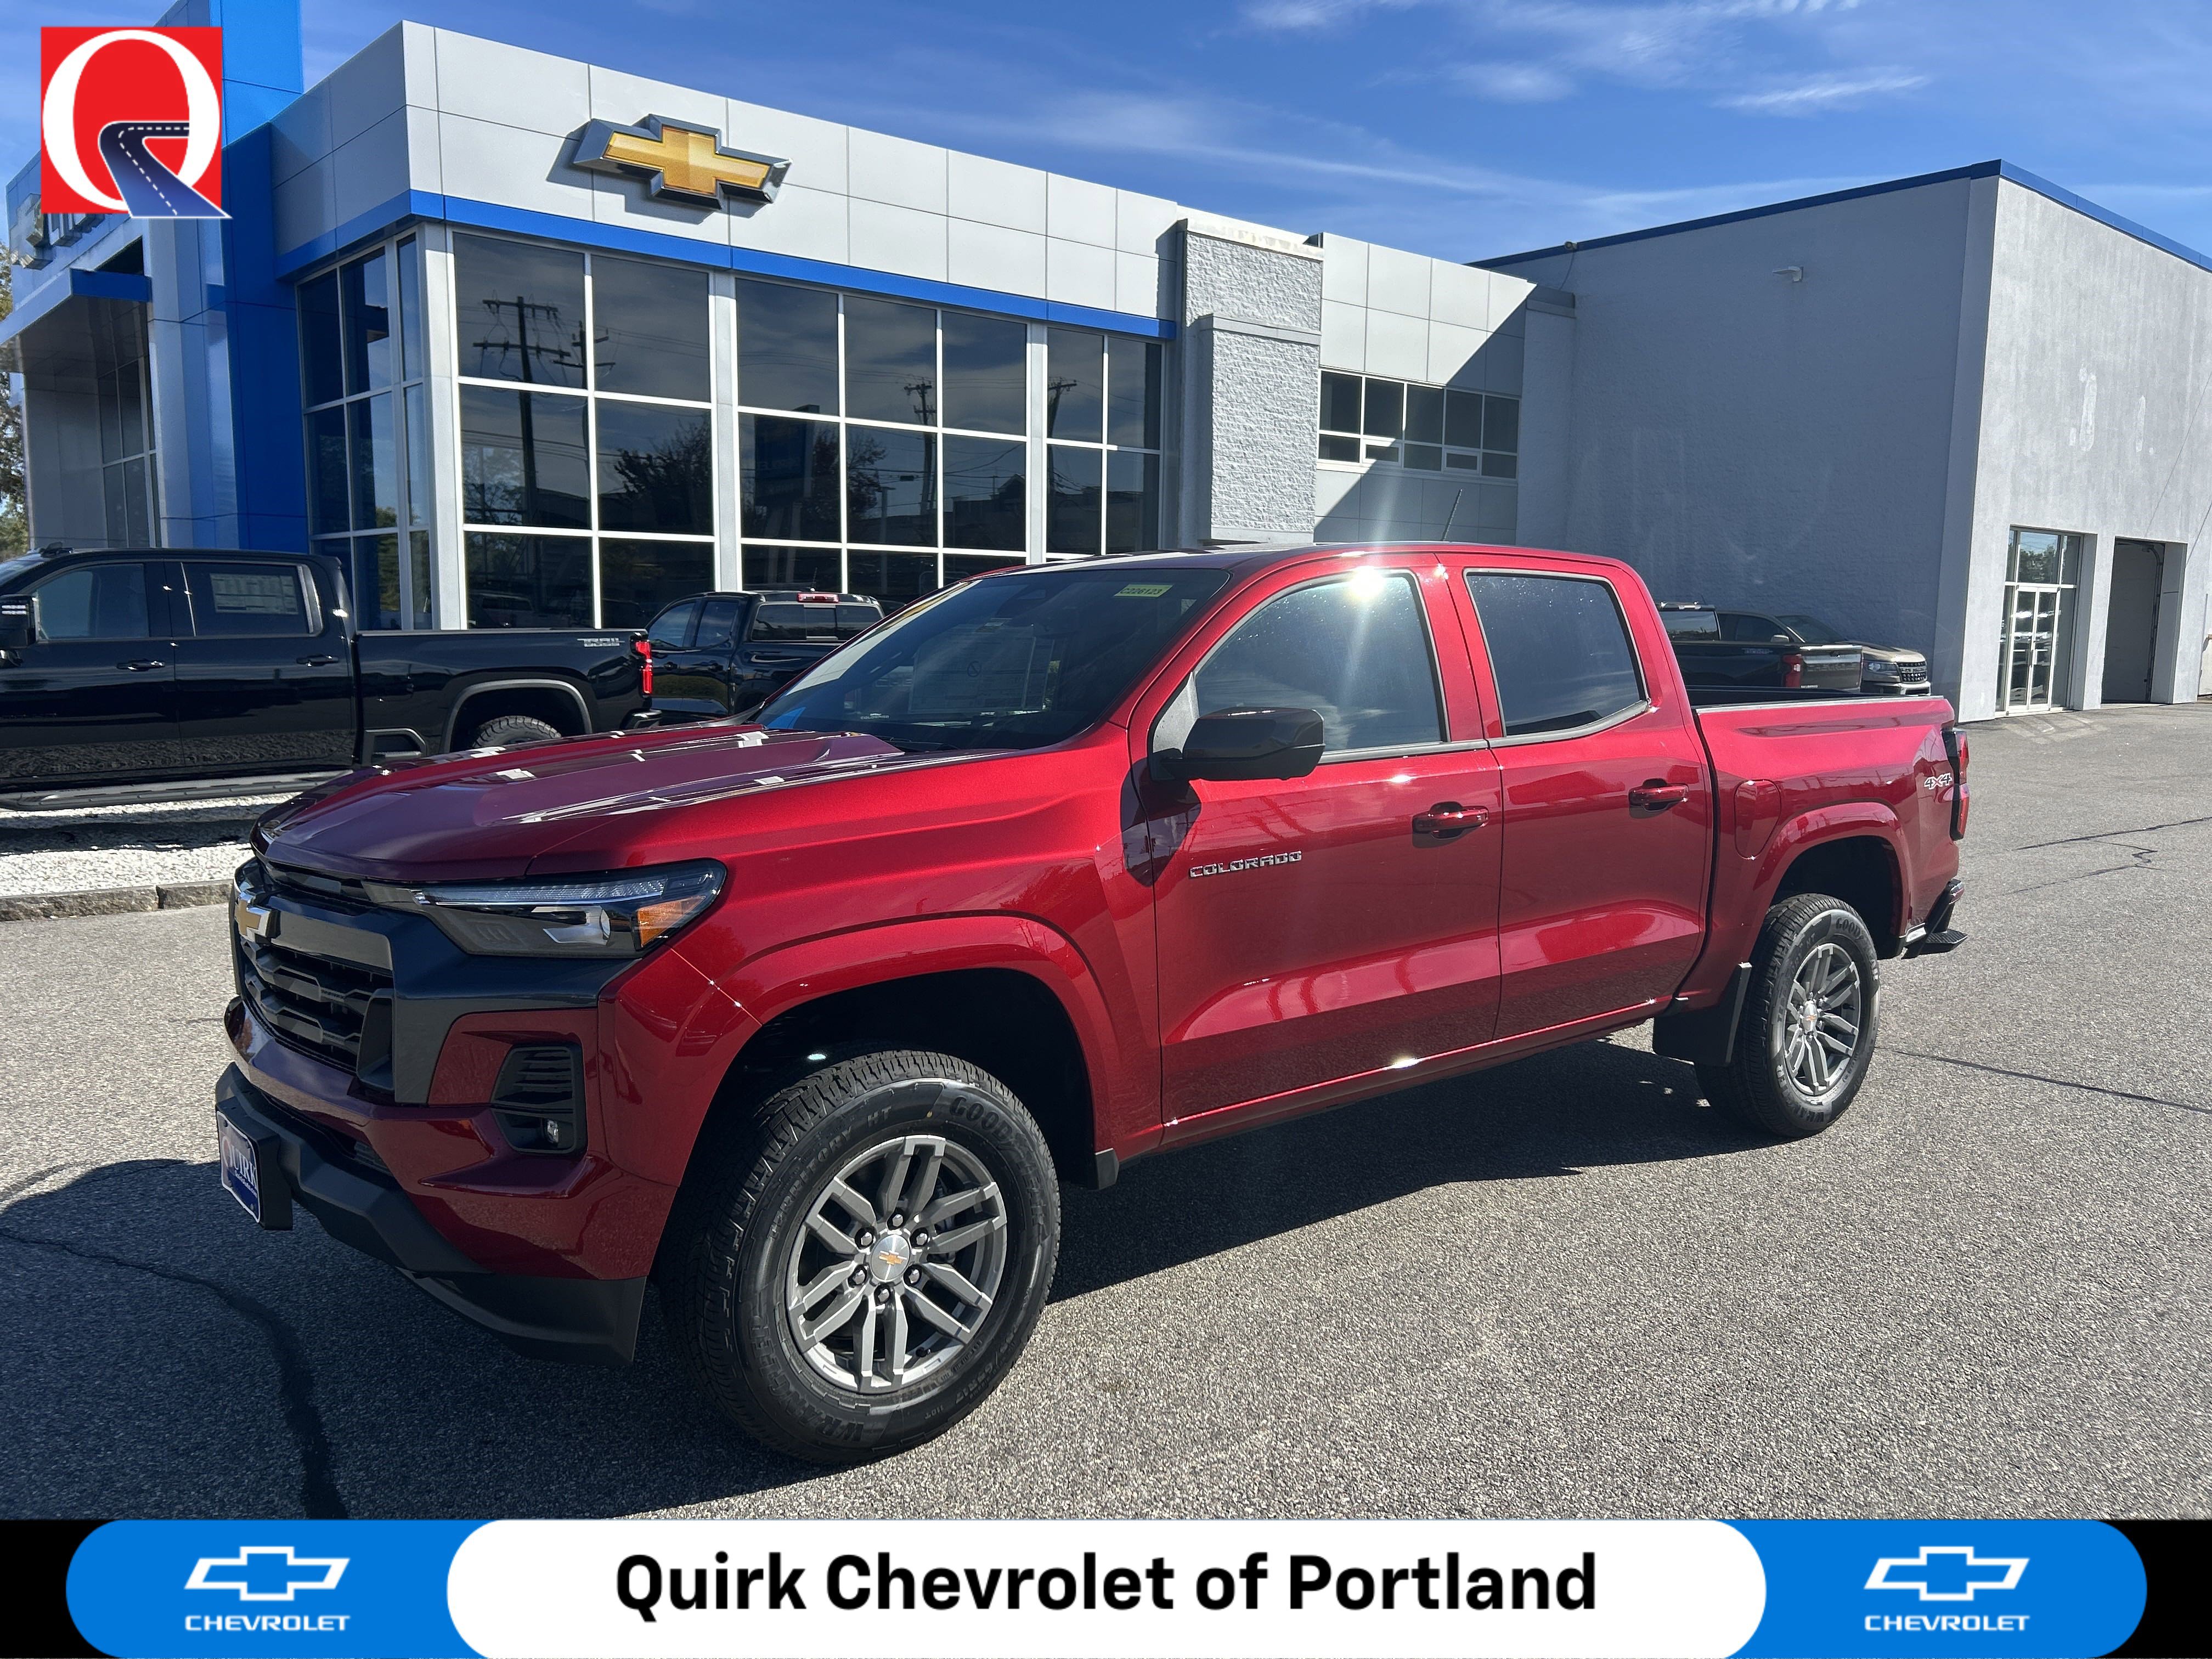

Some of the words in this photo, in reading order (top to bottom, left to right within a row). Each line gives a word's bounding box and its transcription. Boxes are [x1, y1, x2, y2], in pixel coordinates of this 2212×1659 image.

[1189, 850, 1302, 878] COLORADO
[866, 1105, 892, 1127] HT
[221, 1137, 257, 1190] QUIRK
[949, 1097, 1046, 1226] GOODYEAR
[749, 1315, 864, 1442] WRANGLER
